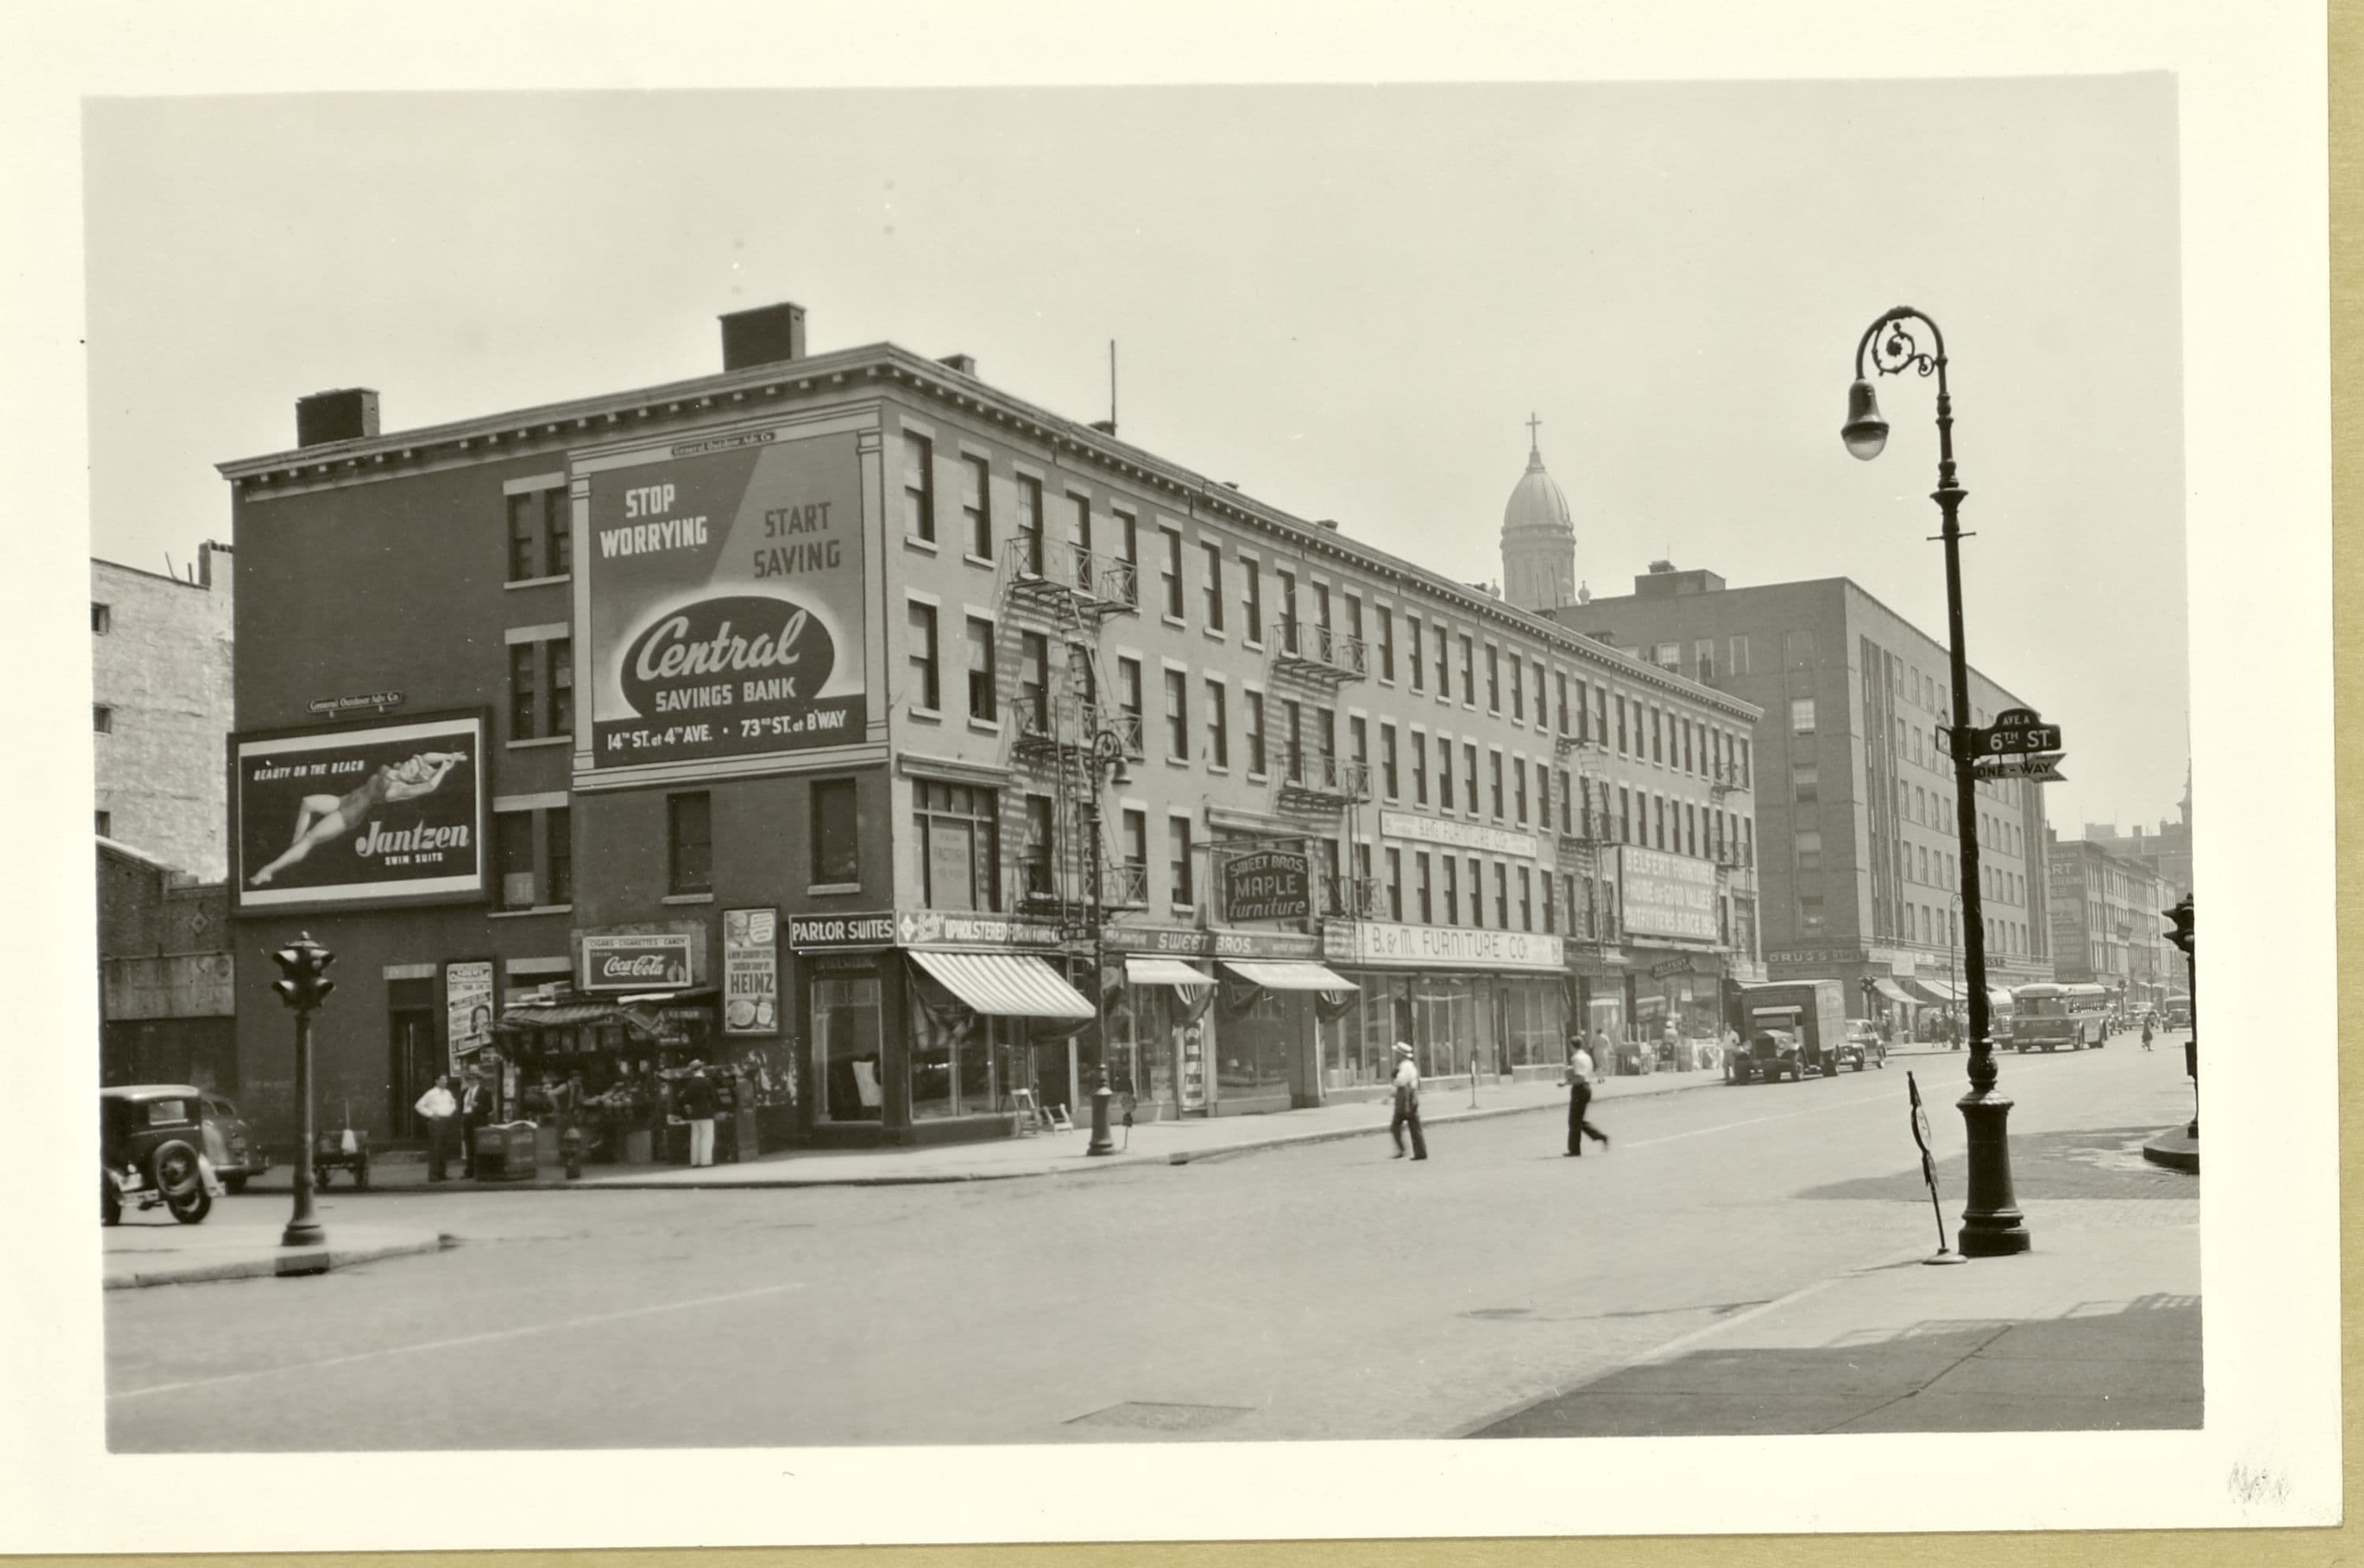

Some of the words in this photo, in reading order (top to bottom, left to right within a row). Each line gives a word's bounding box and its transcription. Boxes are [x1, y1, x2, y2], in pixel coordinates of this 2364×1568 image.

[625, 484, 675, 517] STOP
[764, 502, 832, 538] START
[599, 516, 707, 558] WORRYING
[753, 539, 841, 578] SAVING
[636, 610, 807, 681] Central
[655, 684, 732, 712] SAVINGS
[744, 677, 796, 703] BANK
[632, 730, 650, 747] ST.
[651, 736, 662, 746] at
[683, 724, 712, 743] AVE.
[772, 715, 791, 735] ST.
[792, 721, 803, 732] at
[807, 710, 847, 731] B'WAY
[2024, 715, 2030, 725] A
[1990, 731, 2018, 751] 6TH
[2027, 729, 2052, 748] ST.
[254, 767, 291, 781] BEAUTY
[310, 763, 327, 775] THE
[331, 760, 365, 774] BEACH
[354, 818, 469, 858] Jantzen
[384, 854, 410, 866] SWIM
[415, 852, 443, 864] SUITS
[1230, 855, 1269, 877] SWEET
[1271, 854, 1306, 875] BROS.
[1234, 874, 1298, 898] MAPLE
[1229, 896, 1305, 918] furniture
[792, 920, 844, 941] PARLOR
[848, 918, 893, 940] SUITES
[945, 918, 1008, 941] UPHOLSTERED
[1157, 932, 1208, 951] SWEET
[1215, 936, 1254, 954] BROS.
[1423, 929, 1501, 958] FURNITURE
[1769, 951, 1828, 962] DRUGS
[730, 972, 774, 994] HEINZ
